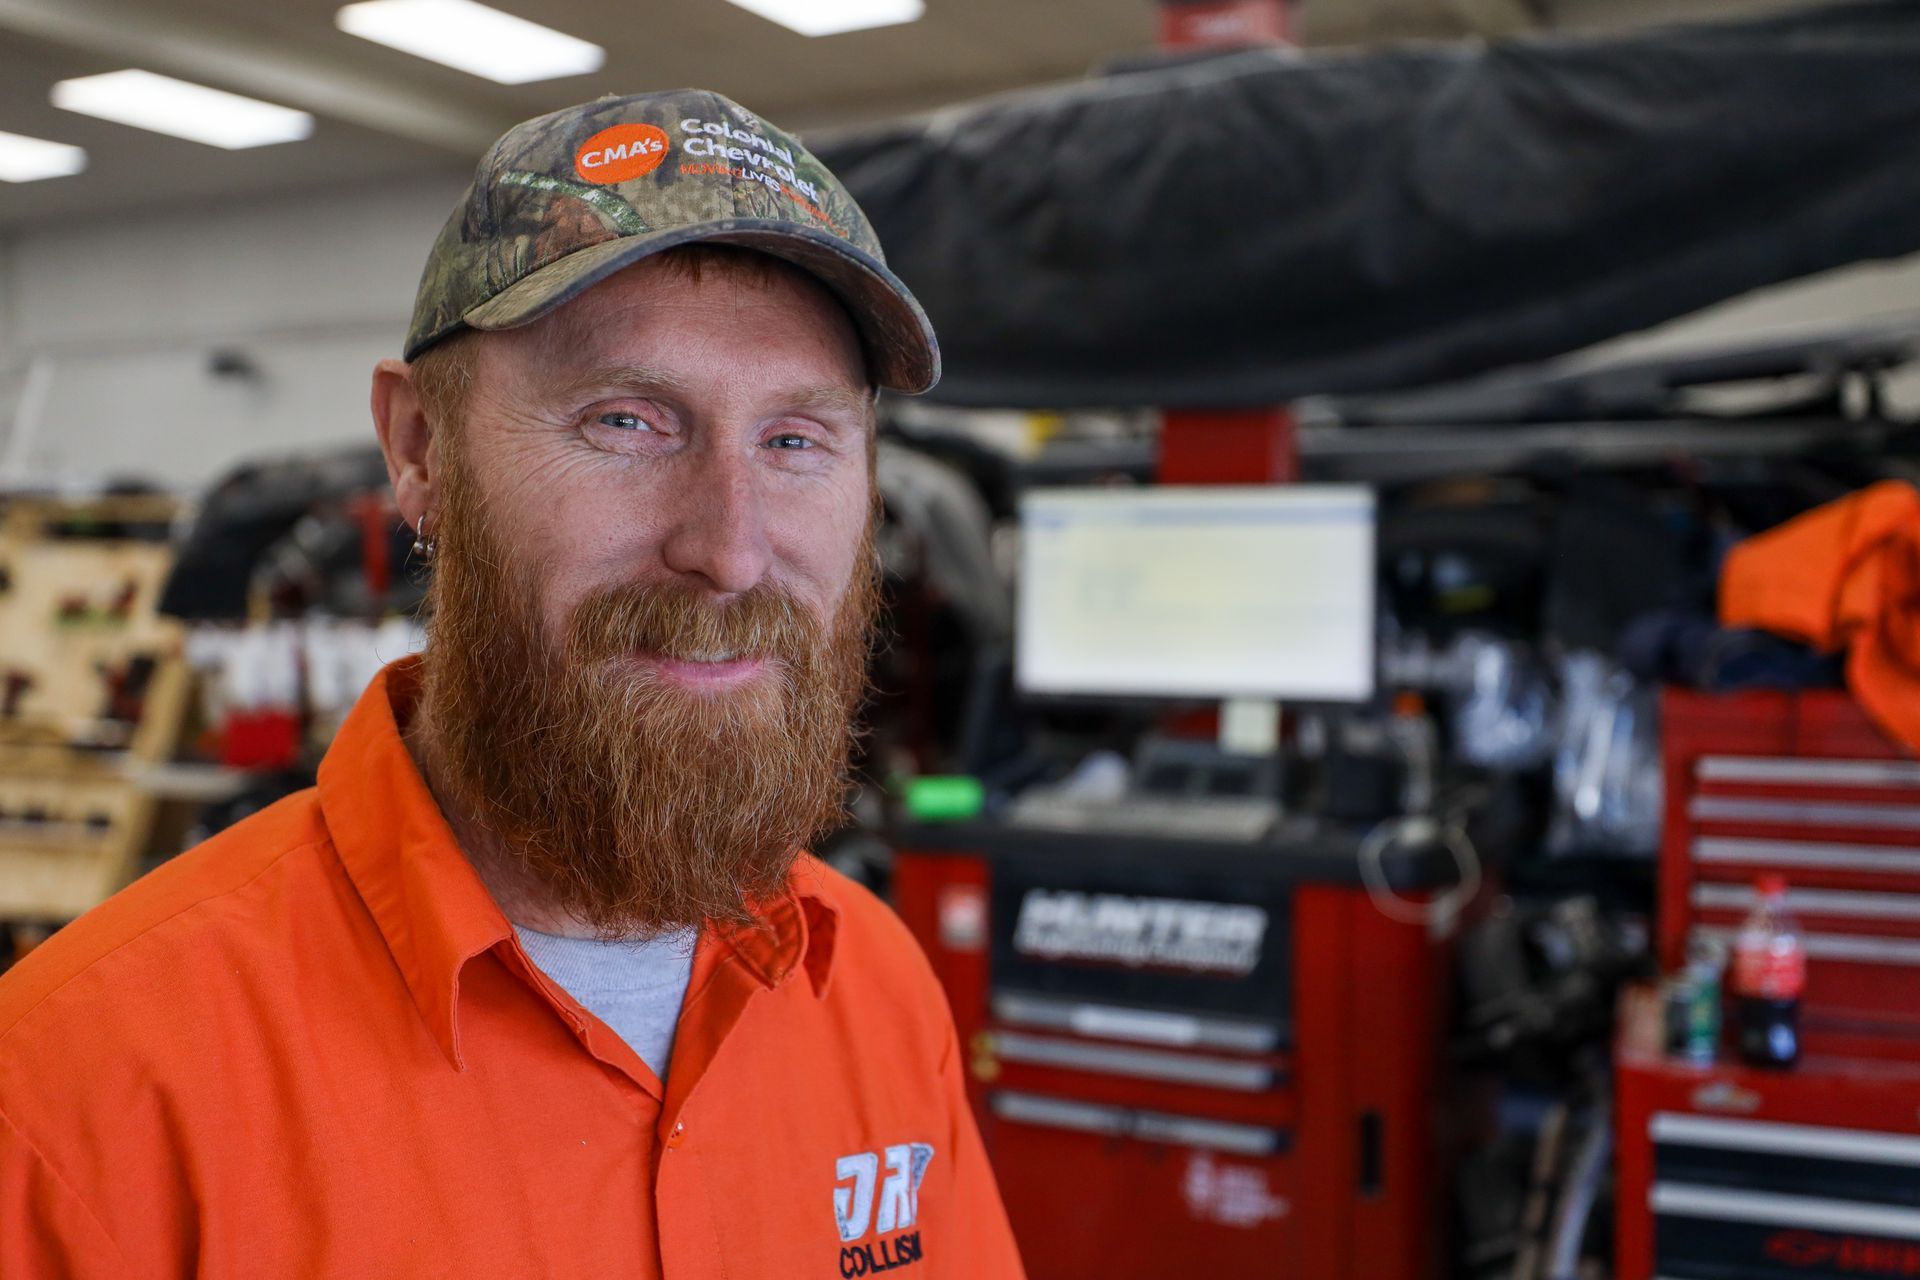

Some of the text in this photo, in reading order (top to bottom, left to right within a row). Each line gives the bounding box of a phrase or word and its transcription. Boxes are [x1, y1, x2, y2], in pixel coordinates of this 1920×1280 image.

[581, 138, 663, 168] CMA's
[680, 118, 796, 169] Colonial
[682, 137, 820, 204] Chevrolet
[742, 168, 781, 192] LIVES
